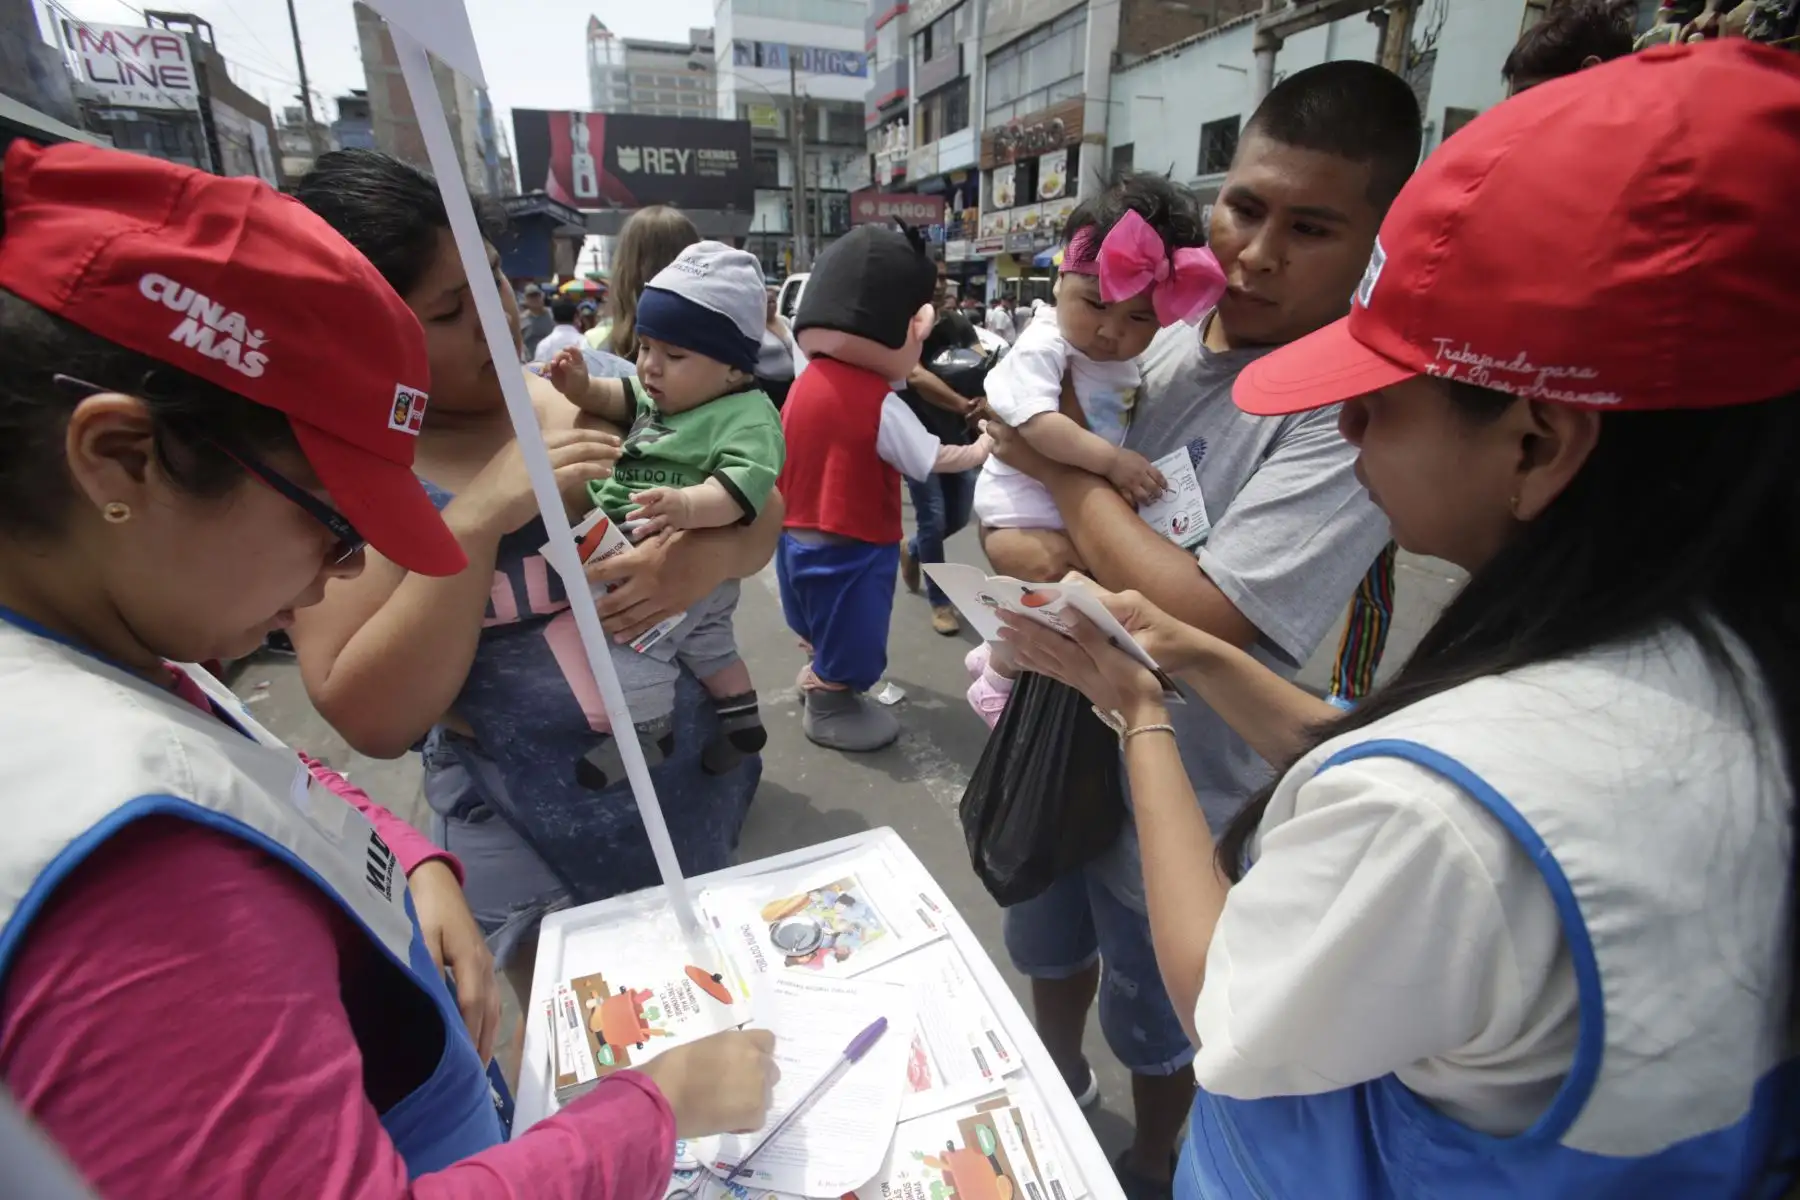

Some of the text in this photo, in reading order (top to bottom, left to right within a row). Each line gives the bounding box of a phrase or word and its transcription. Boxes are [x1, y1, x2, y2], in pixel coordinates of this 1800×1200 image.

[79, 24, 184, 61] MYA
[85, 57, 191, 90] LINE
[642, 146, 690, 175] REY
[139, 272, 247, 344] CUNA
[644, 469, 666, 483] DO
